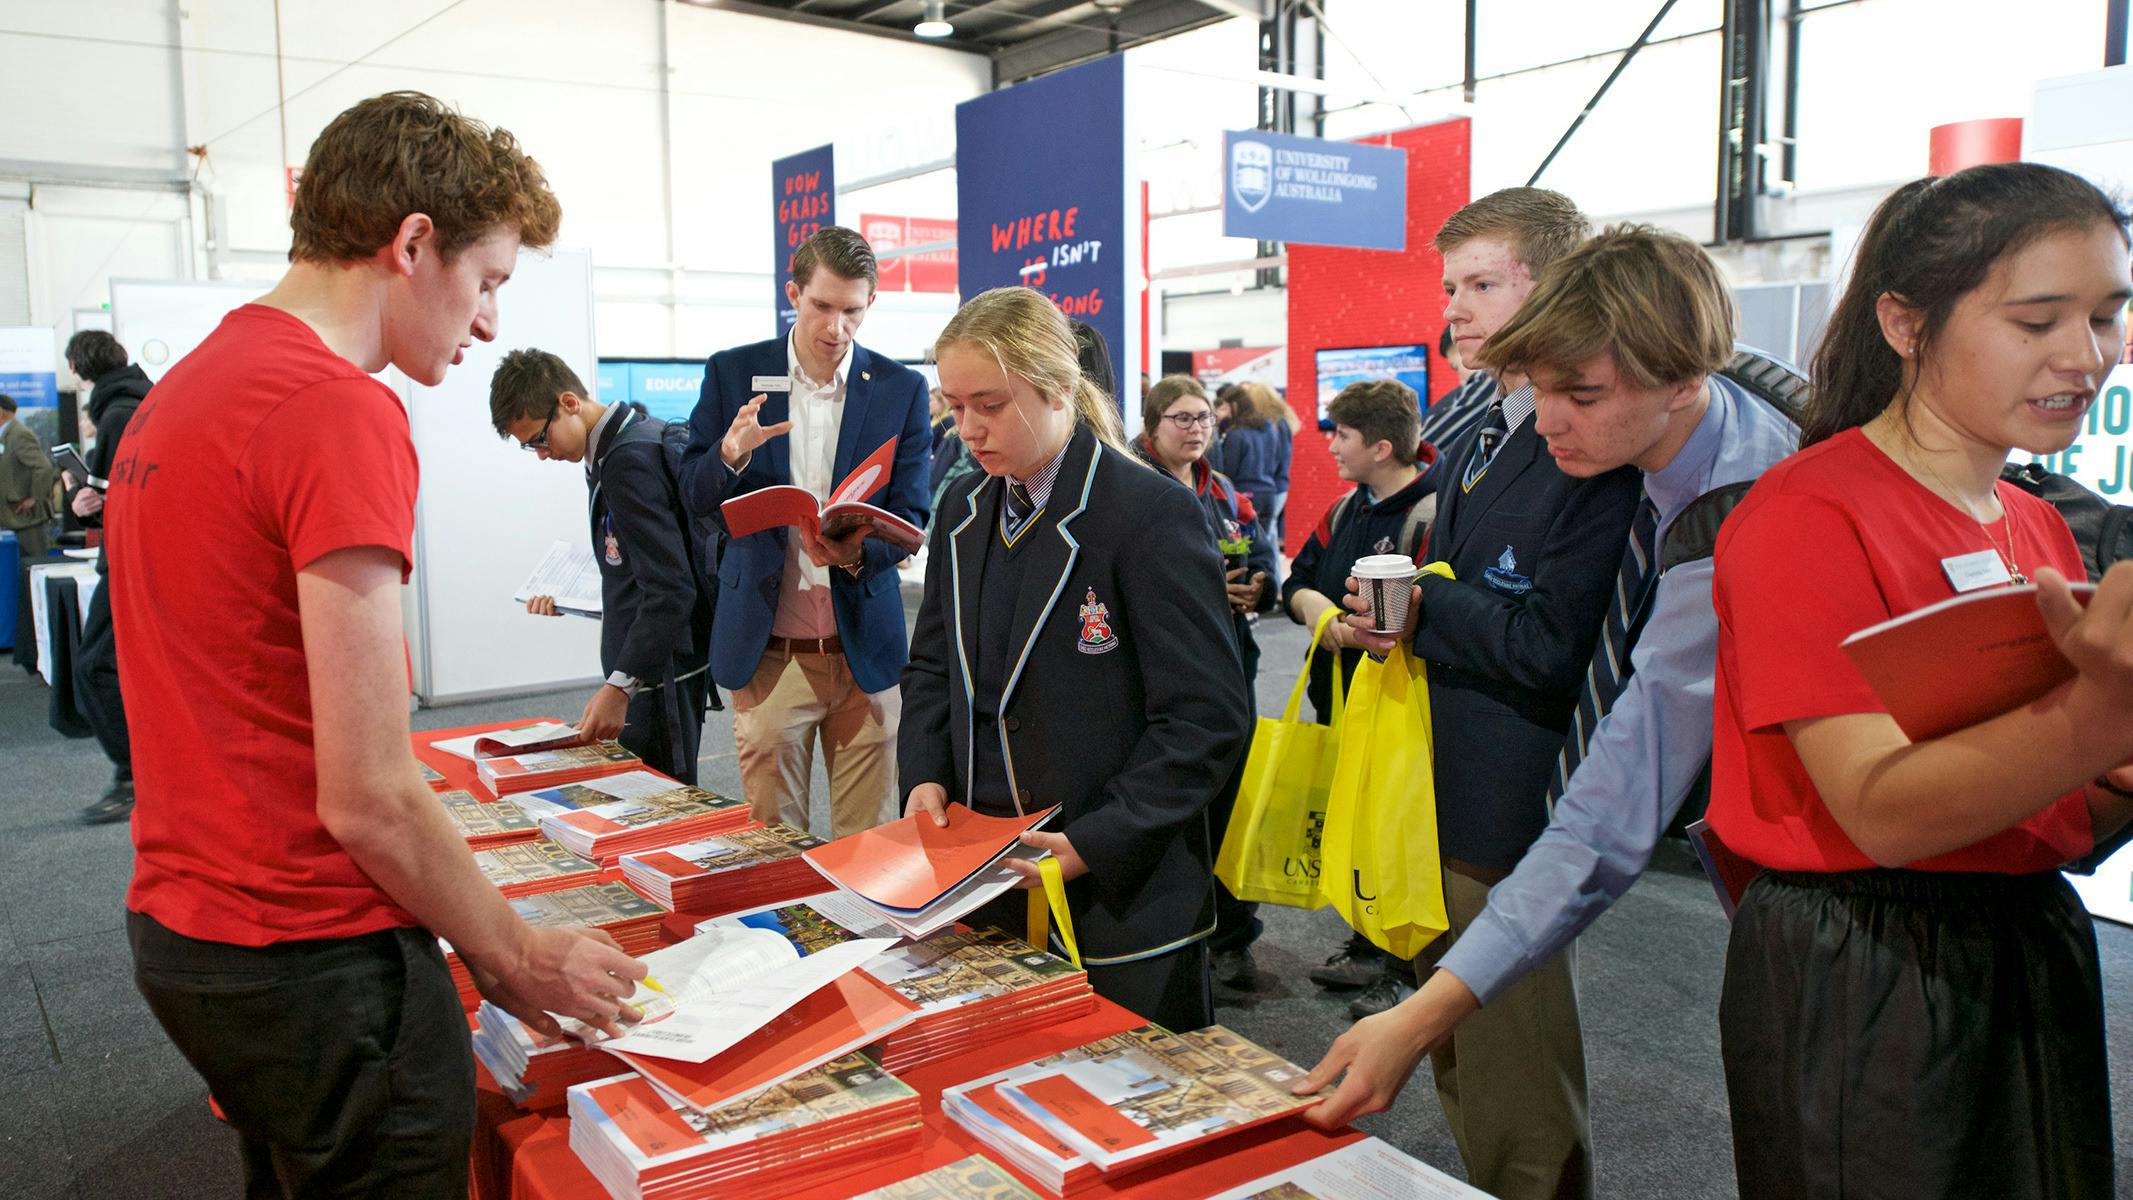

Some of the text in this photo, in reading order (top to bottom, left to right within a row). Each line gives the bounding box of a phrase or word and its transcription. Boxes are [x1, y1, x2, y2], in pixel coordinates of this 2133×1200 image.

[1276, 149, 1350, 172] UNIVERSITY
[785, 170, 821, 196] UOW
[1275, 165, 1378, 190] OF WOLLONGONG
[1274, 182, 1343, 202] AUSTRALIA
[778, 191, 829, 225] GRADS
[991, 207, 1078, 253] WHERE
[1052, 240, 1102, 266] ISN'T
[1020, 255, 1048, 286] IS
[2098, 445, 2133, 495] J
